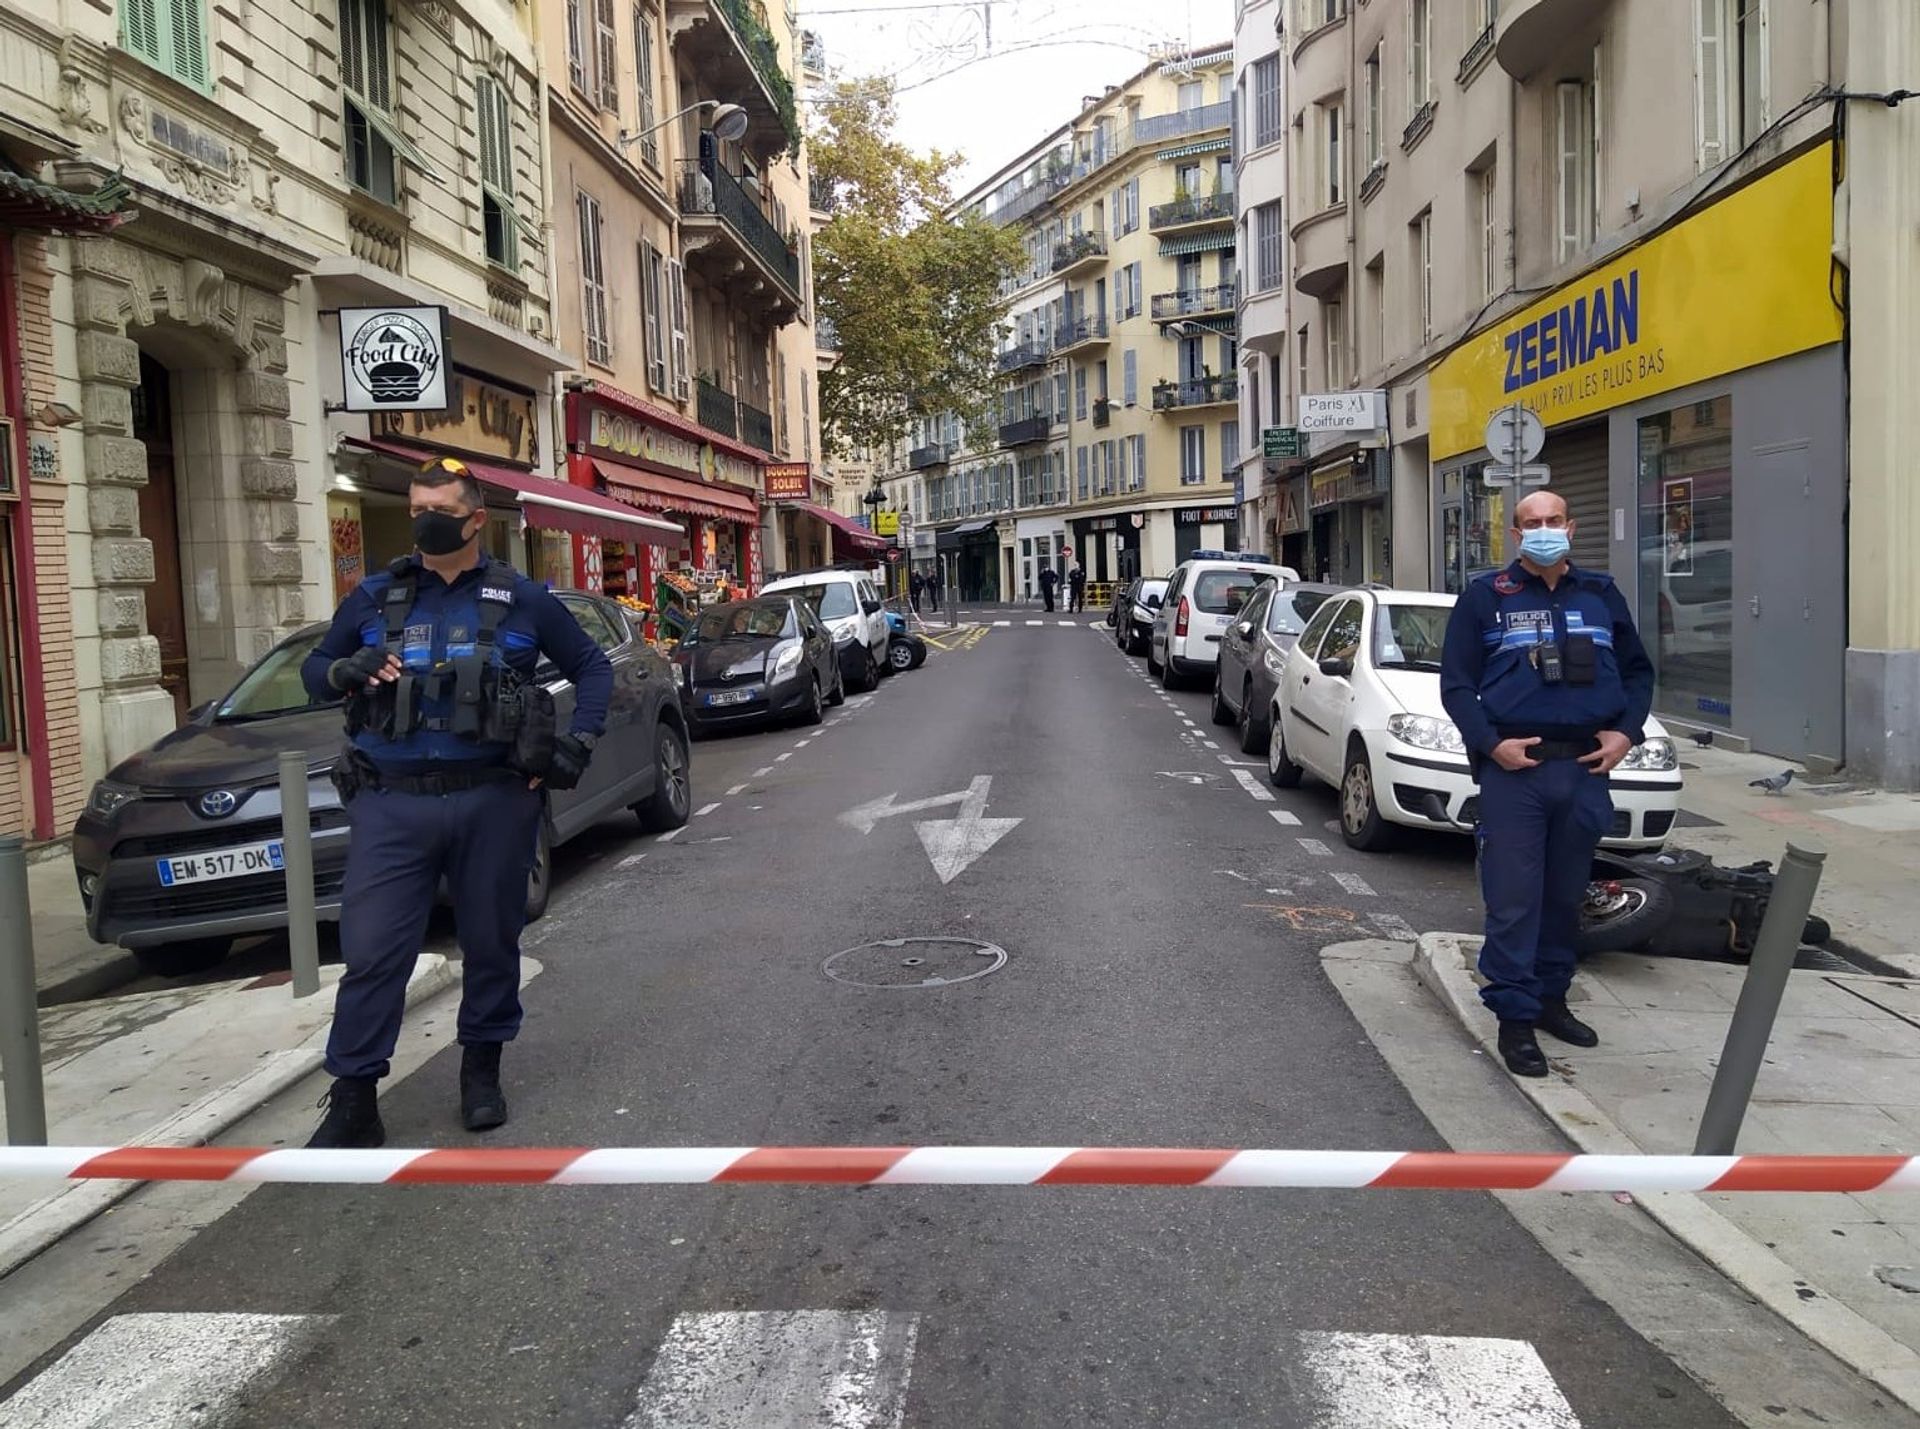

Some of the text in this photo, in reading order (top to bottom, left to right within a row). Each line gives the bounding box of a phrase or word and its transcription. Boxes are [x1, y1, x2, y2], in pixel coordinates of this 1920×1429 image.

[384, 316, 405, 325] PIZZA
[1504, 269, 1639, 394] ZEEMAN
[345, 343, 440, 371] Food City
[1529, 393, 1549, 414] AUX
[1552, 380, 1575, 406] PRIX
[1579, 372, 1598, 399] LES
[1602, 359, 1633, 391] PLUS
[1639, 348, 1665, 379] BAS
[1308, 398, 1344, 411] Paris
[1302, 414, 1355, 429] Coiffure
[597, 410, 700, 472] BOUCHERIE
[766, 464, 808, 477] BOUCHERIE
[772, 478, 803, 490] SOLEIL
[1181, 509, 1200, 523] FOOT
[482, 587, 512, 599] POLICE
[1511, 612, 1549, 622] POLICE
